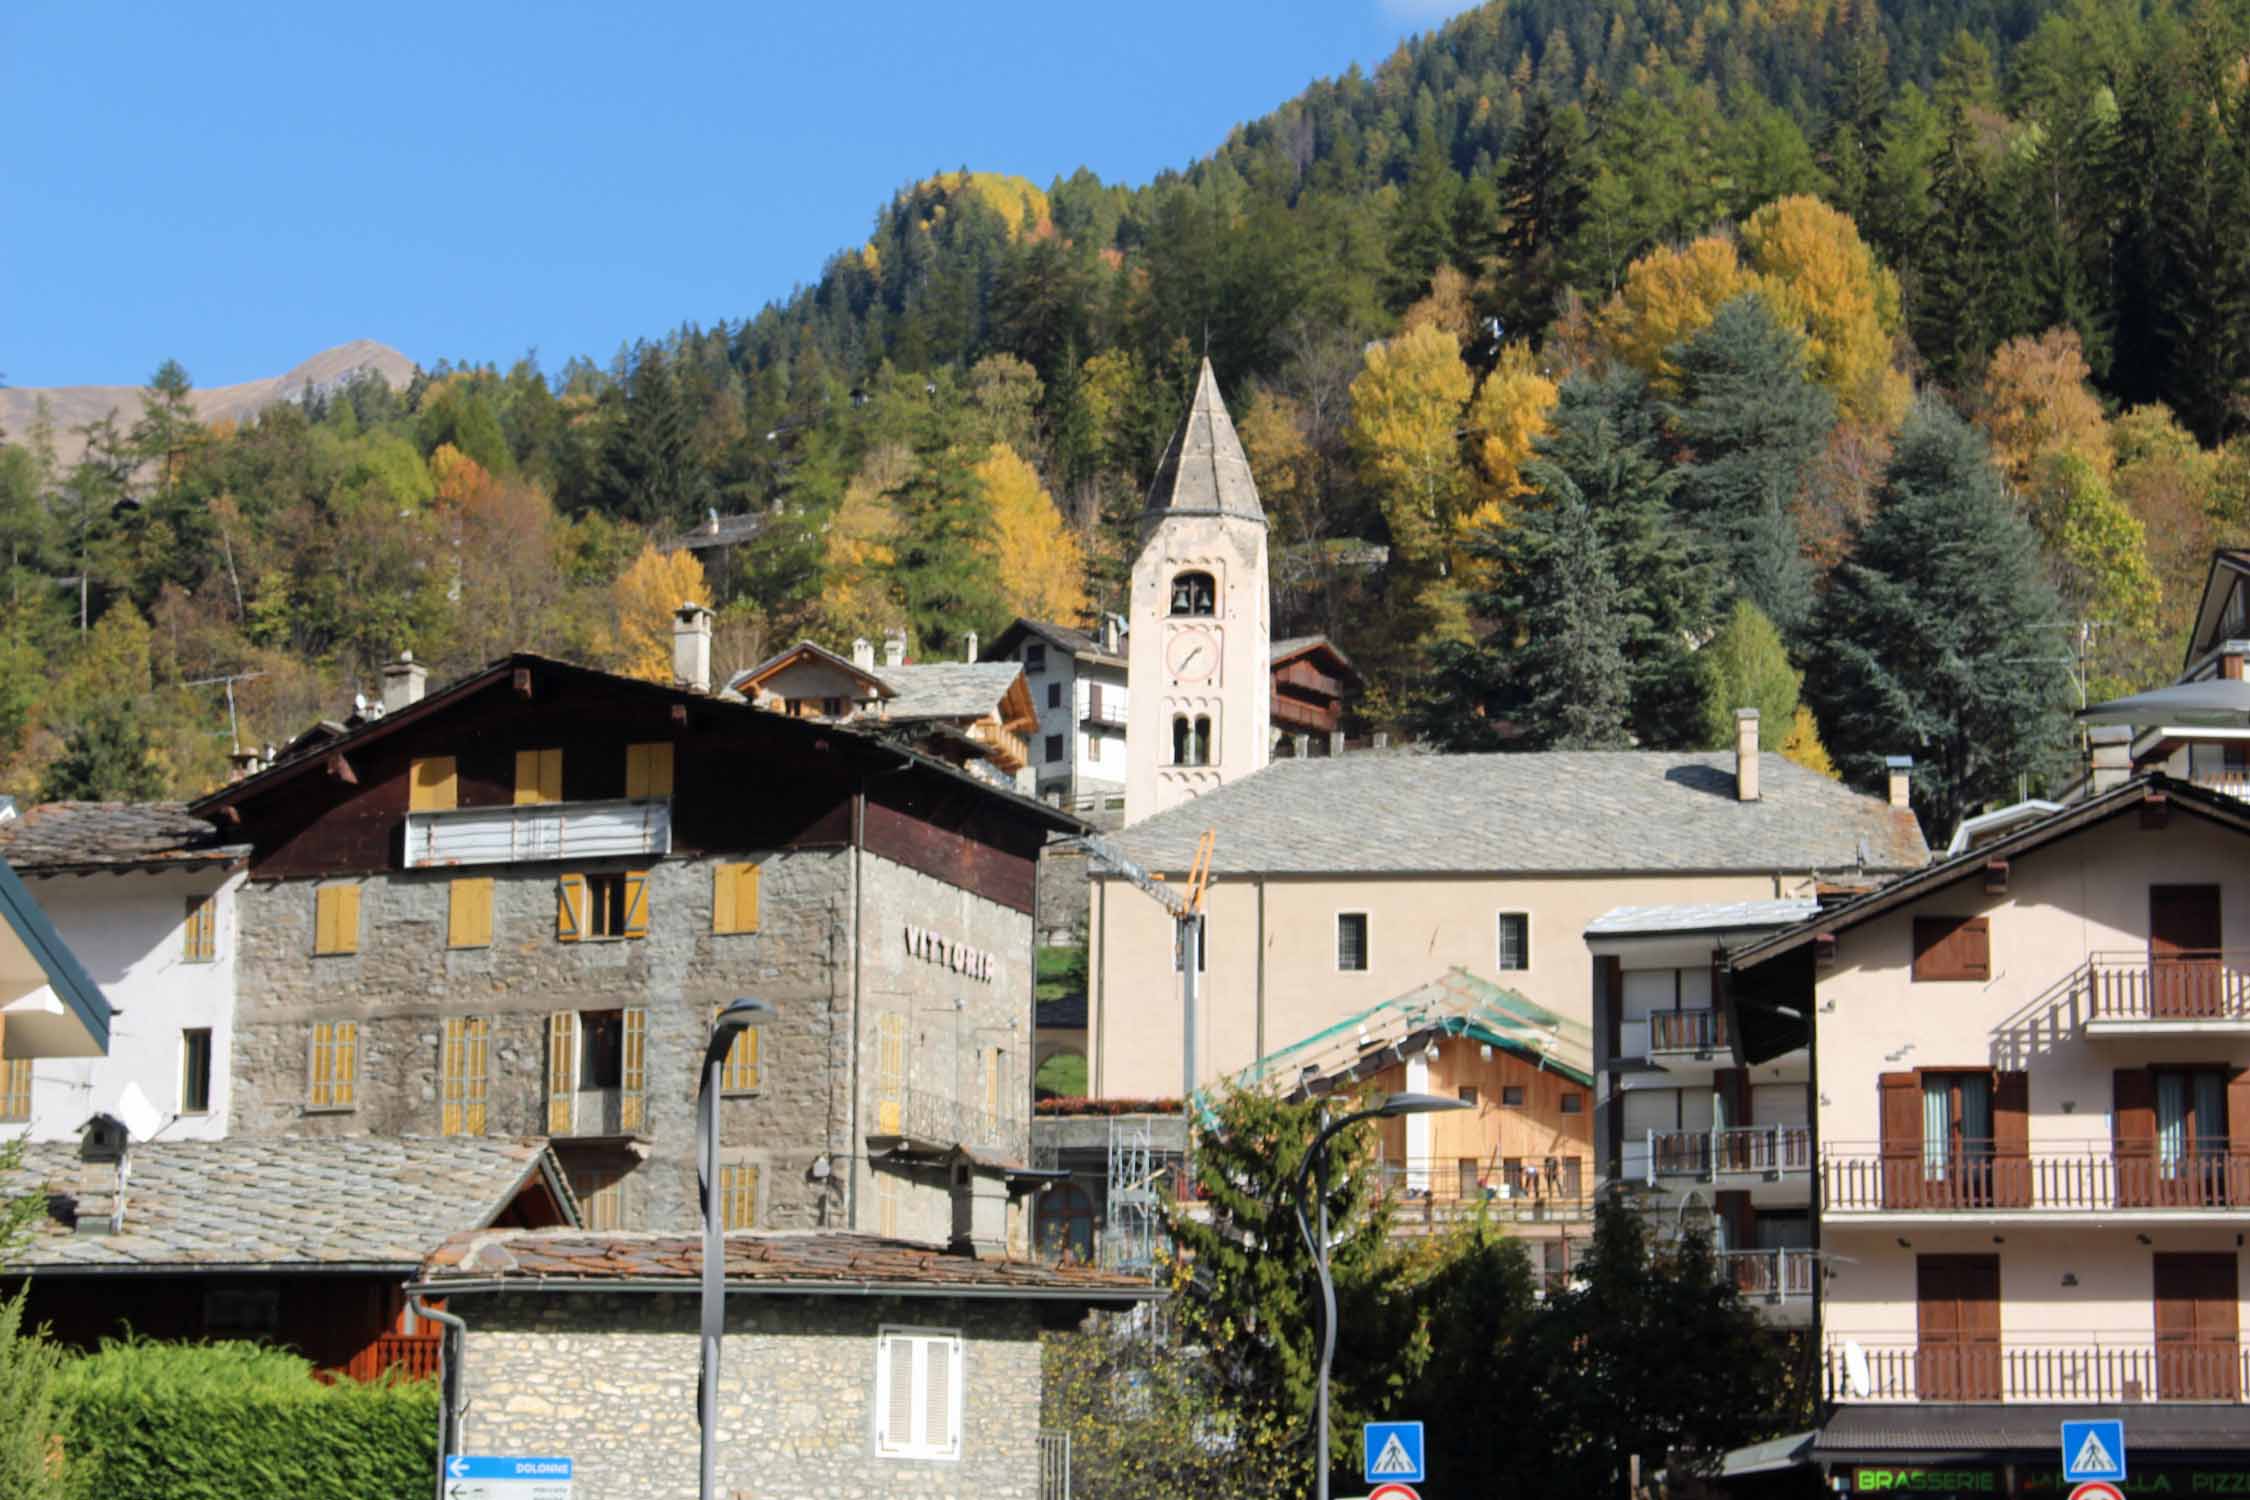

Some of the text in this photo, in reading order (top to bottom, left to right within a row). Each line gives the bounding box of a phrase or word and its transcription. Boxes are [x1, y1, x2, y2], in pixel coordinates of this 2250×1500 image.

[515, 1463, 569, 1474] DOLONNE
[1858, 1470, 1993, 1491] BRASSERIE
[2191, 1471, 2250, 1493] PIZZ
